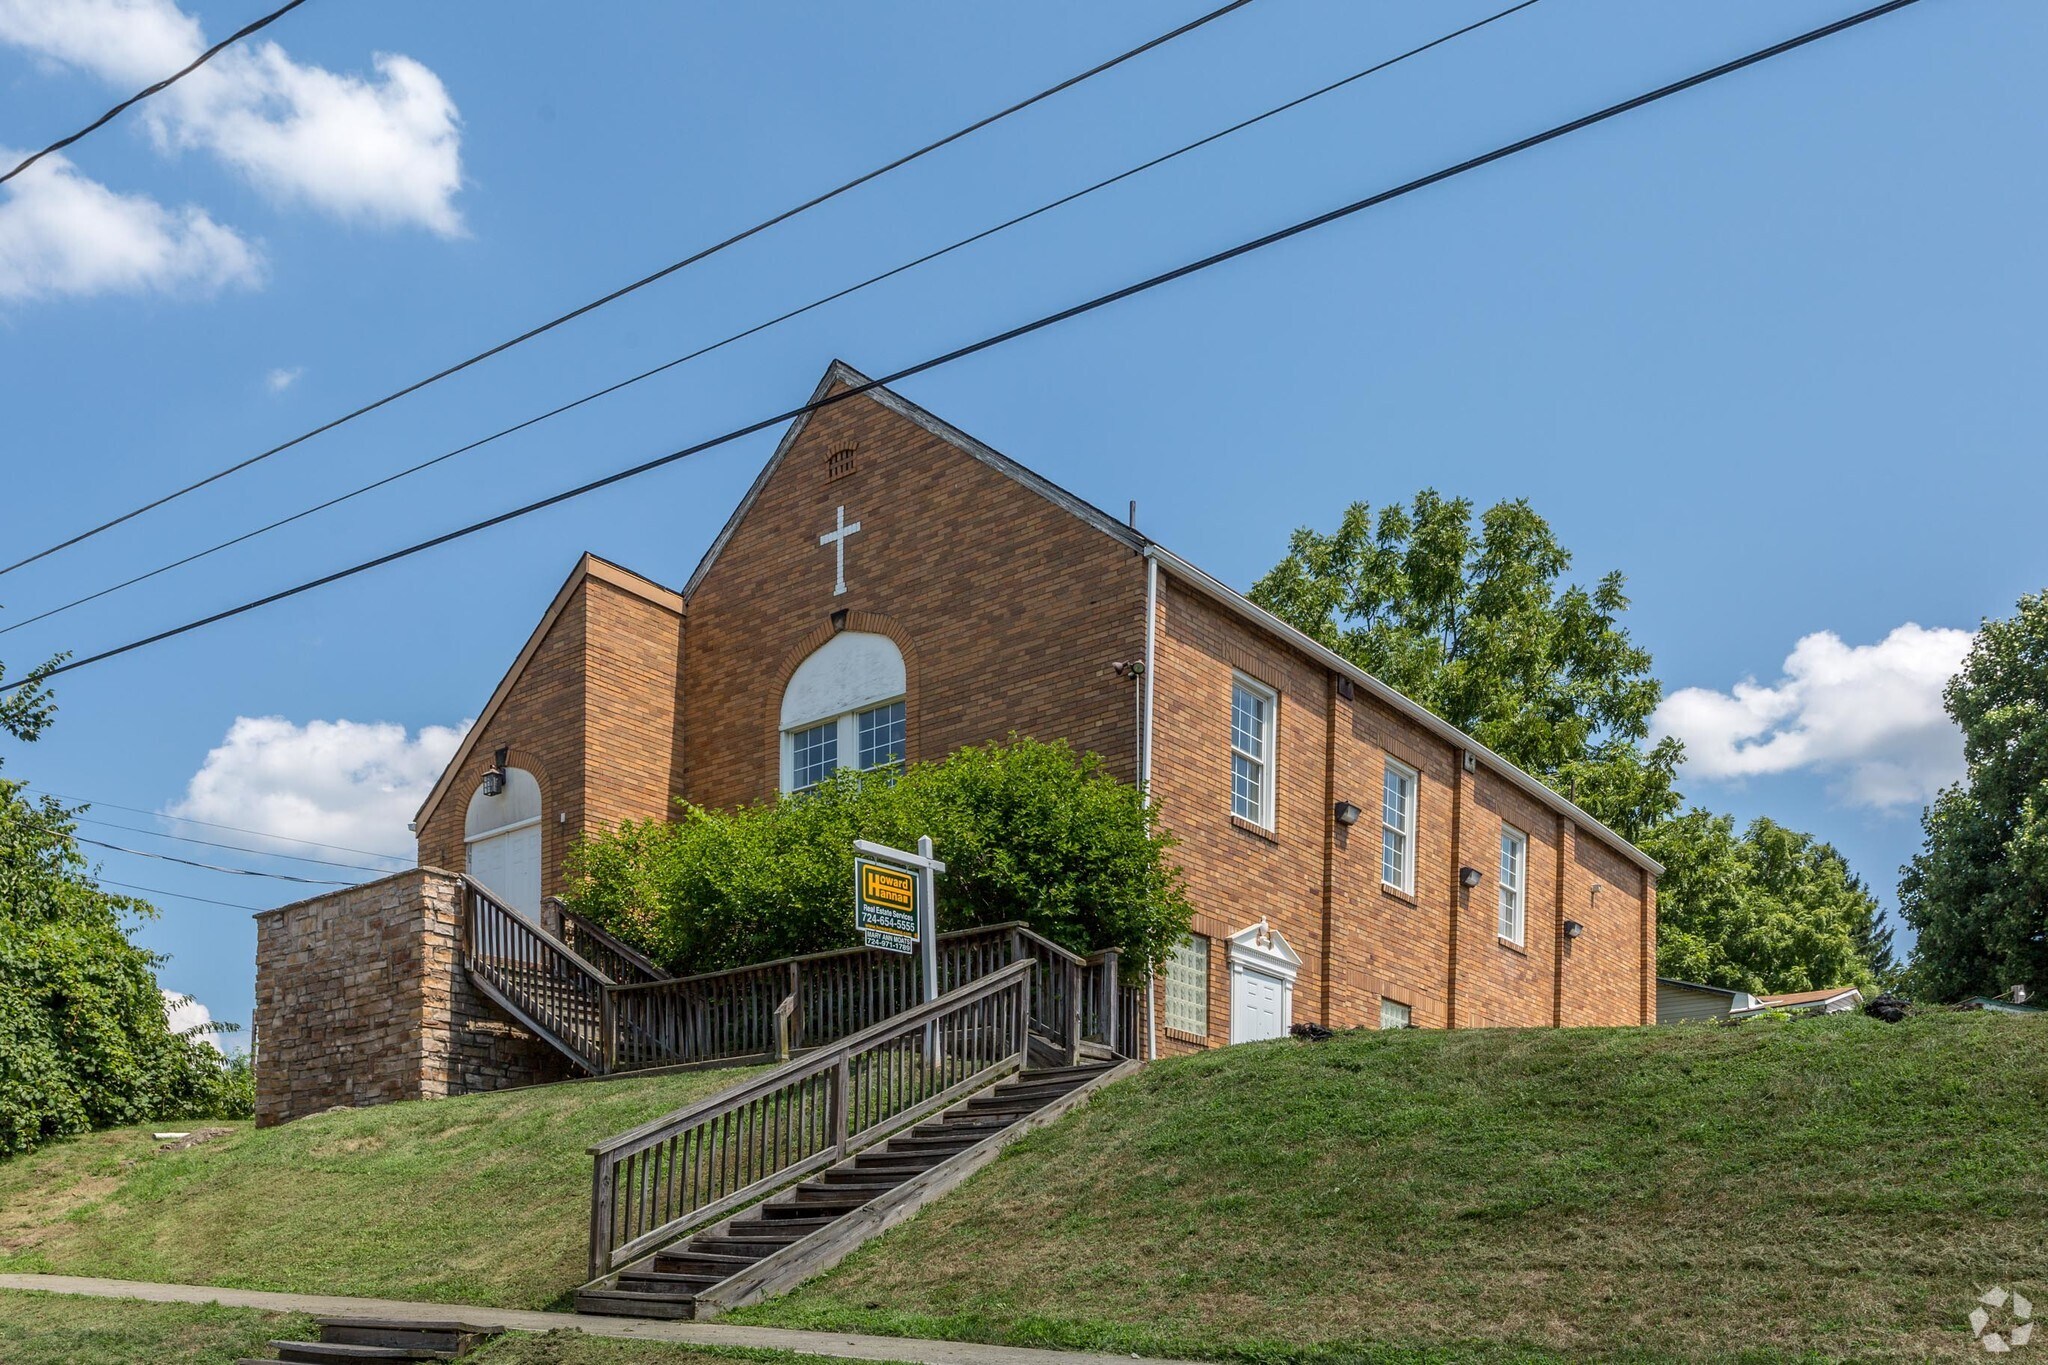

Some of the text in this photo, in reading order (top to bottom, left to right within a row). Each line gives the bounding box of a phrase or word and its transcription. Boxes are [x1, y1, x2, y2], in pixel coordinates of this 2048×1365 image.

[868, 872, 908, 889] Howard
[863, 904, 913, 921] Real Estate Services
[862, 912, 915, 932] 724-654-5555
[867, 931, 910, 945] MARY ANN MOATS
